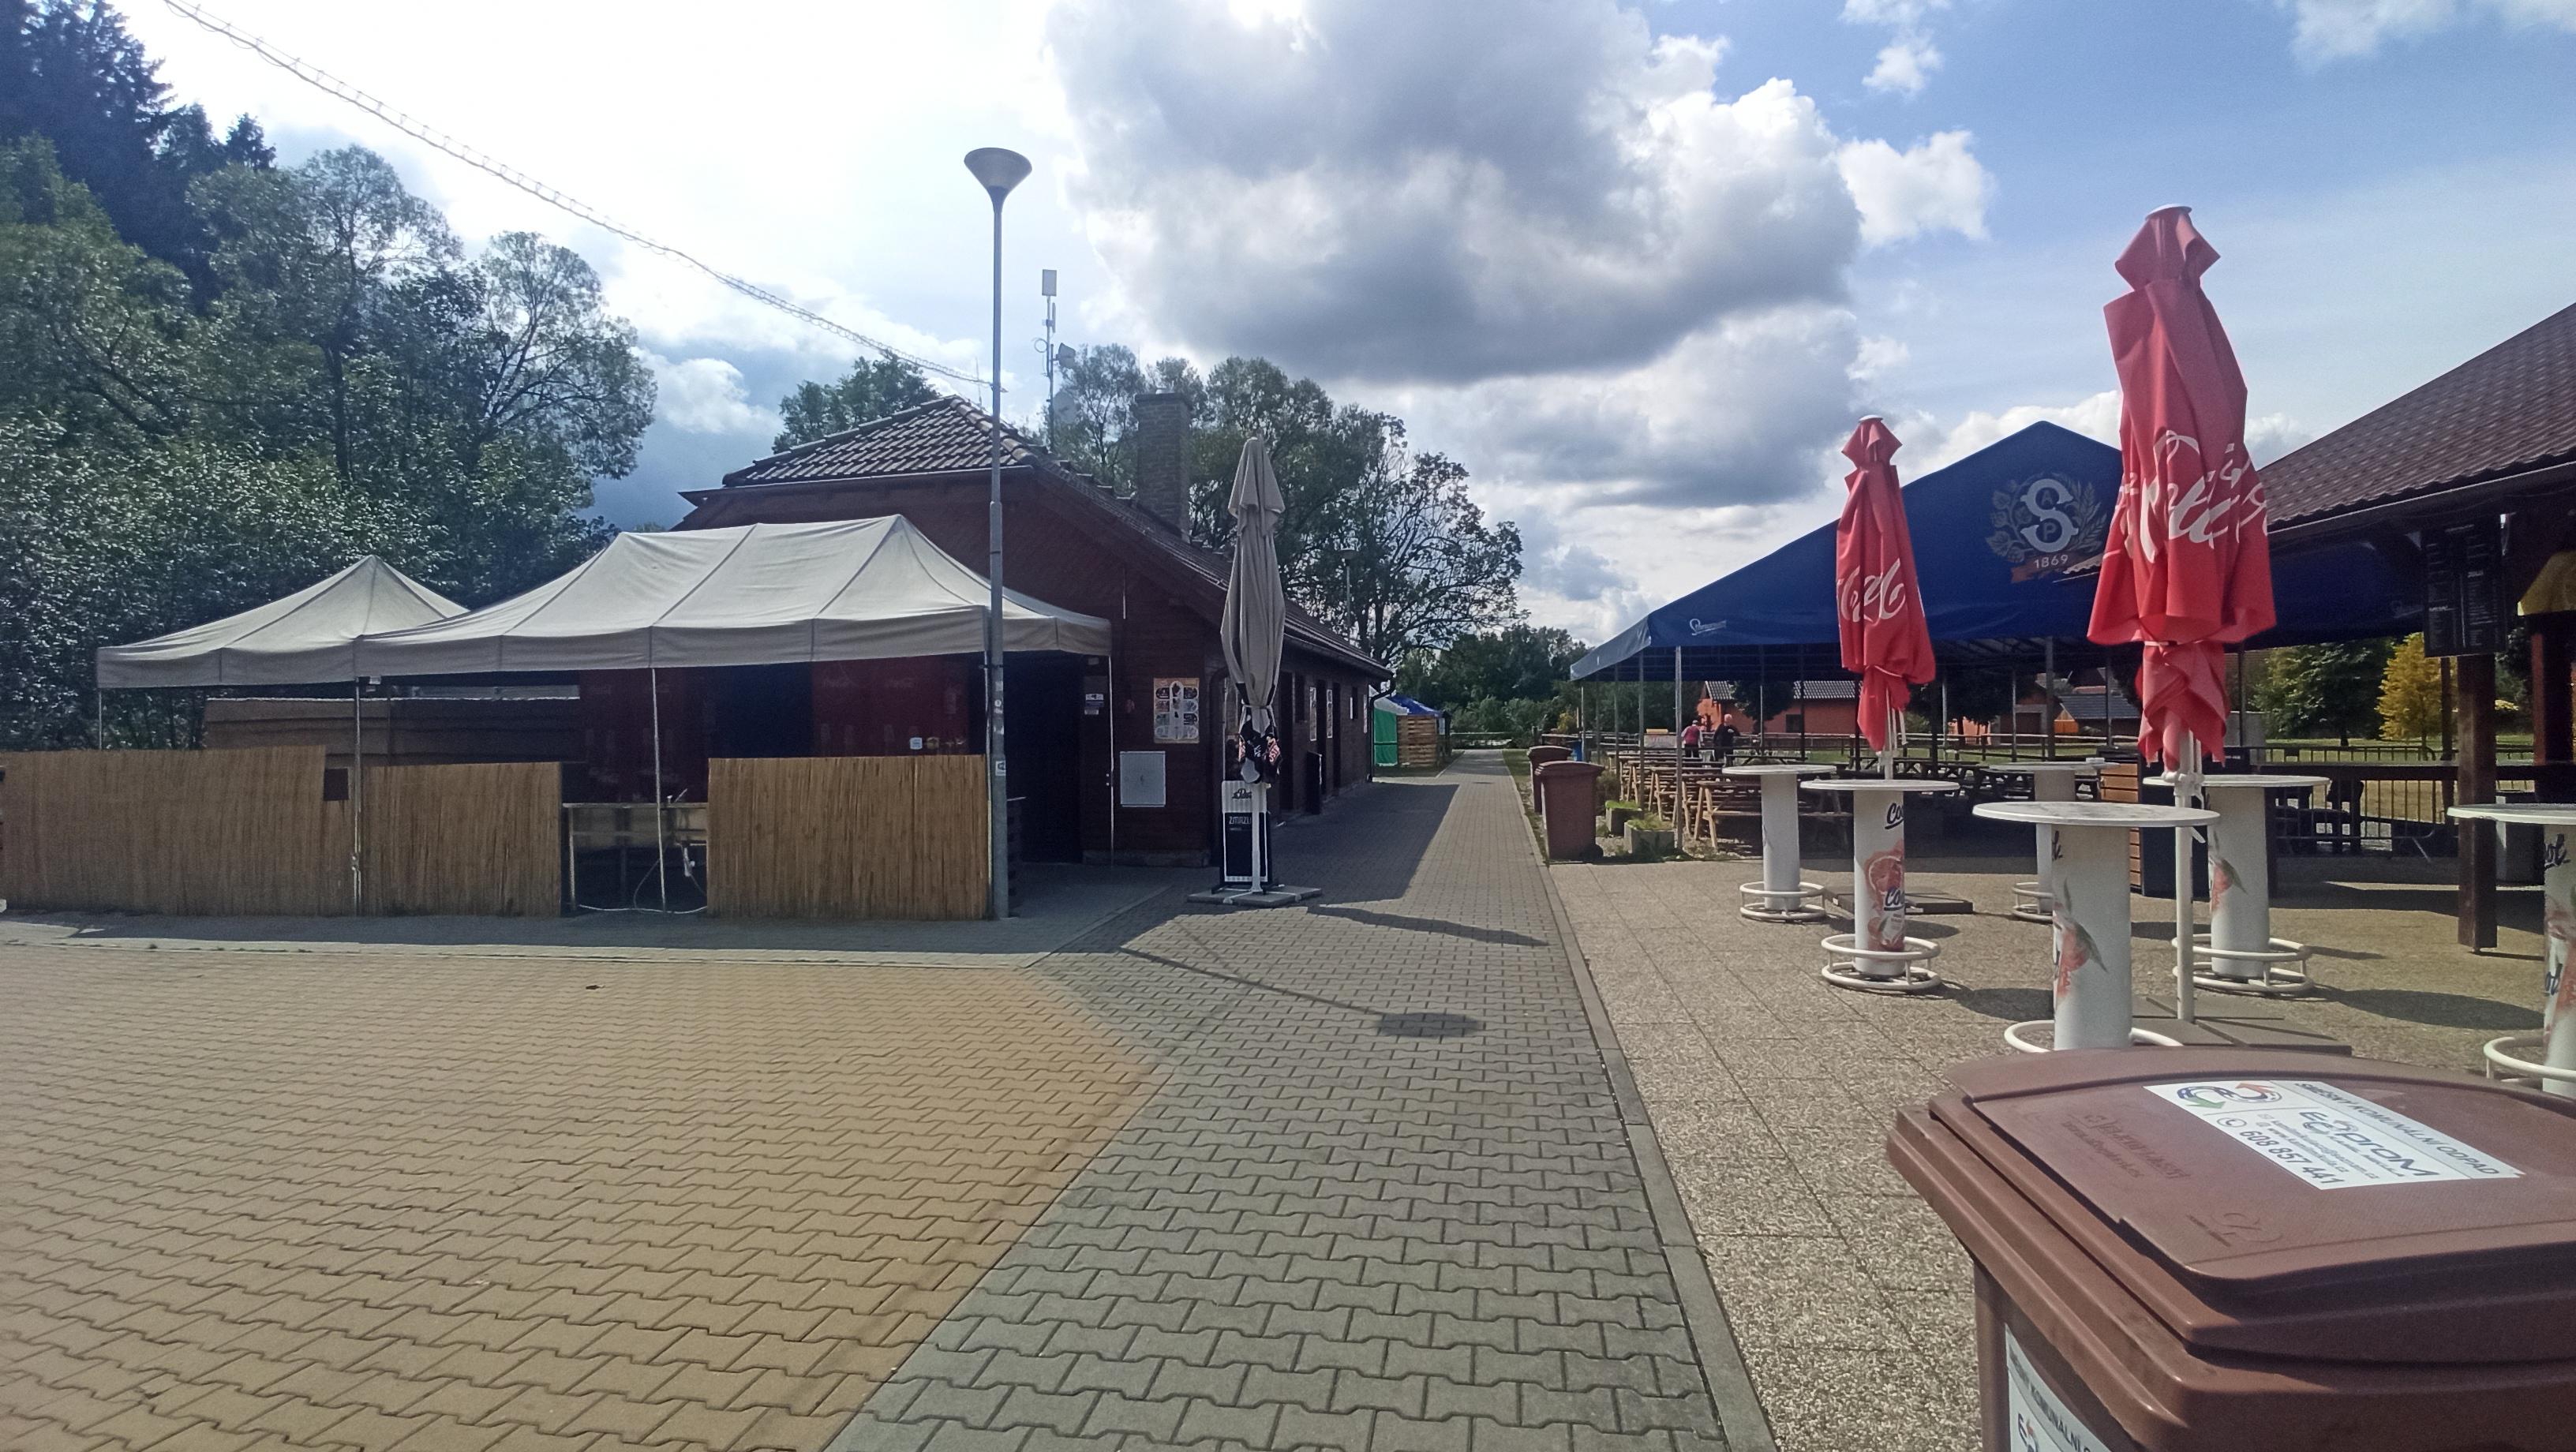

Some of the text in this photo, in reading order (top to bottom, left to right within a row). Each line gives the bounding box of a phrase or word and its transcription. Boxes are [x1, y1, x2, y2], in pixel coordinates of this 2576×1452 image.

[2035, 554, 2069, 568] 1869
[2239, 1131, 2345, 1184] 608 857 441
[2436, 1146, 2500, 1174] ODPAD
